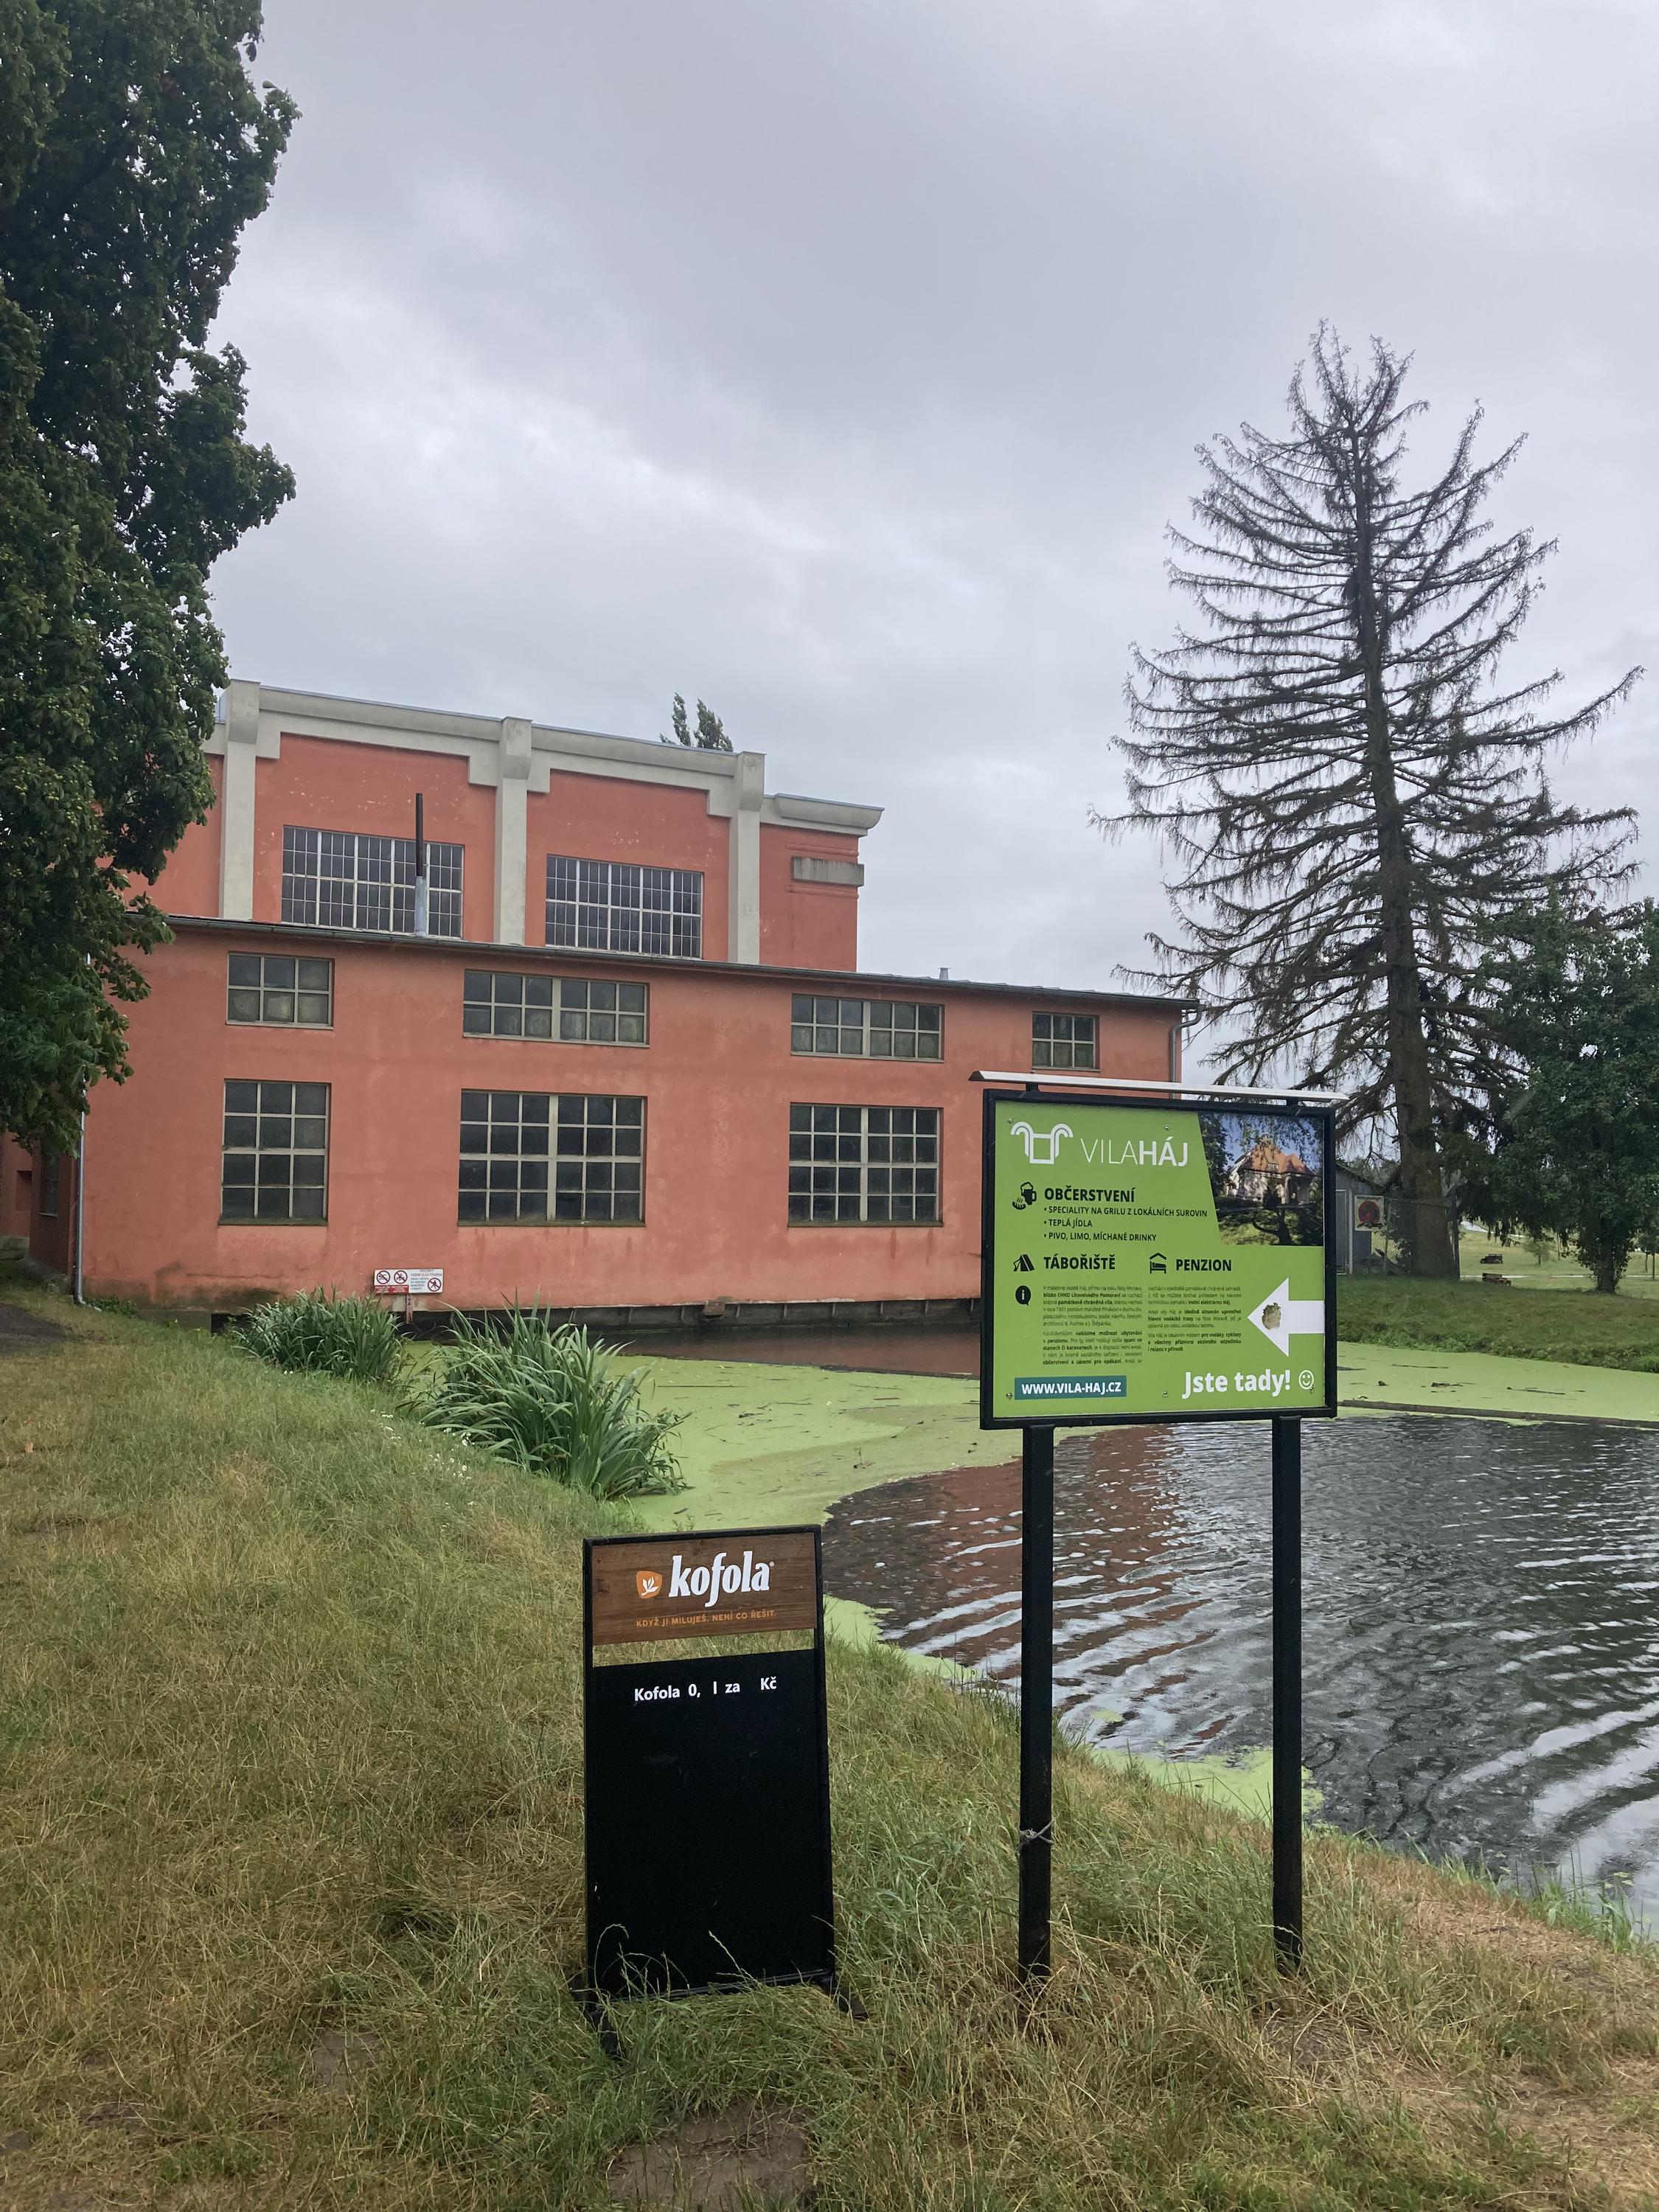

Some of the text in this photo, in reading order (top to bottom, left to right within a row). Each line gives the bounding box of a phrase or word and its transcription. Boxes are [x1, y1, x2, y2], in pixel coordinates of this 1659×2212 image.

[1081, 1136, 1188, 1166] VILAHÁJ
[1044, 1186, 1135, 1202] OBČERSTVENÍ
[1048, 1206, 1089, 1214] SPECIALITY
[1133, 1207, 1175, 1216] LOKÁLNÍCH
[1048, 1217, 1092, 1228] TEPLÁ JÍDLA
[1048, 1232, 1068, 1241] PIVO,
[1070, 1233, 1091, 1241] LIMO,
[1093, 1232, 1127, 1241] MÍCHANÉ
[1043, 1253, 1116, 1271] TÁBOŘIŠTĚ
[1176, 1259, 1232, 1273] PENZION
[1022, 1381, 1121, 1395] WWW.VILA-HAJ.CZ
[1182, 1368, 1290, 1399] Jste tady!
[669, 1551, 770, 1607] kofola
[637, 1617, 659, 1627] KDYŽ
[661, 1618, 668, 1627] JI
[672, 1615, 709, 1625] MILUJEŠ,
[712, 1612, 733, 1621] NENÍ
[635, 1685, 681, 1701] Kofola
[688, 1683, 700, 1697] 0,
[725, 1683, 740, 1694] za
[760, 1676, 777, 1690] Kč
